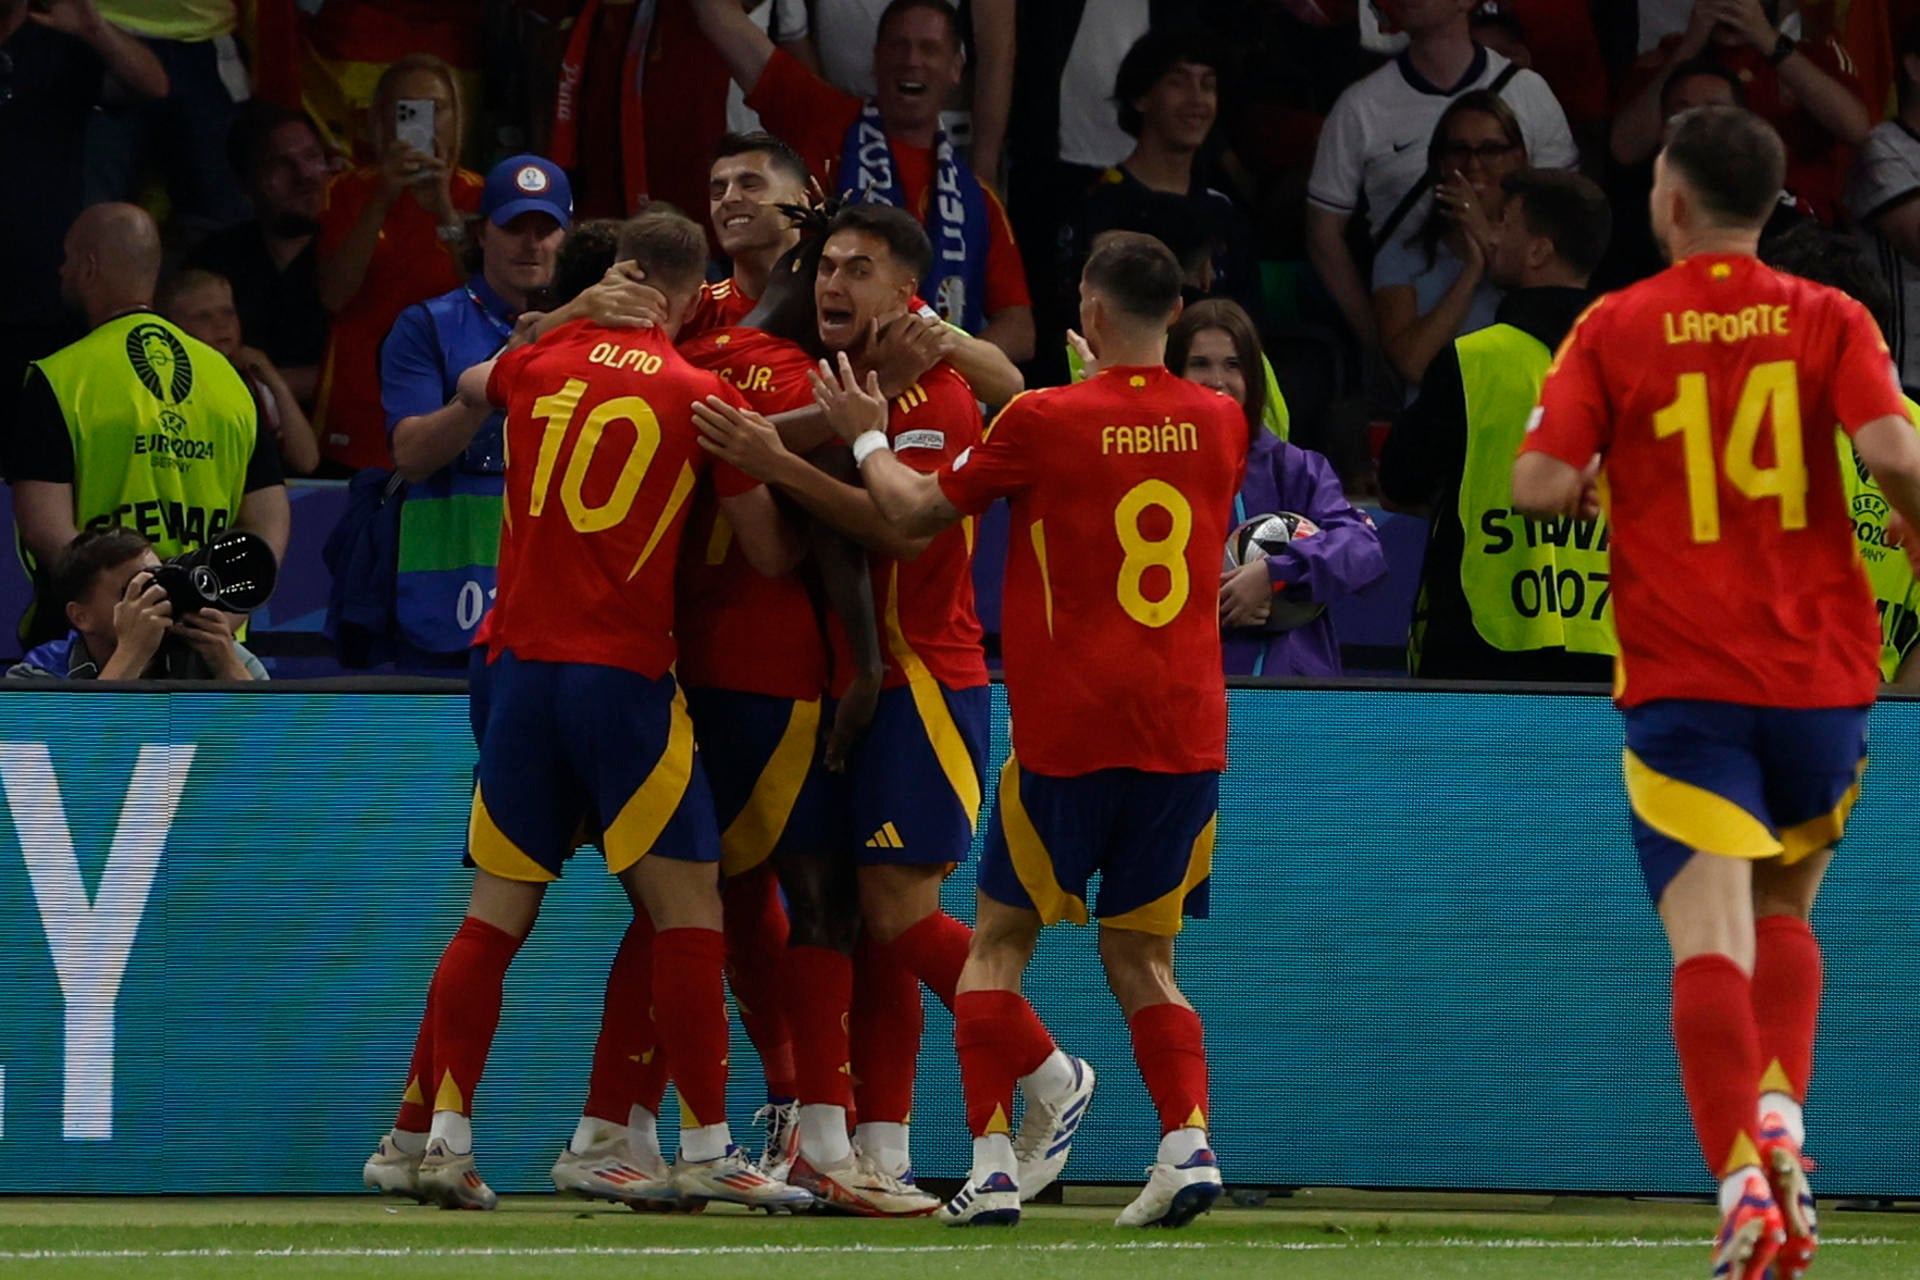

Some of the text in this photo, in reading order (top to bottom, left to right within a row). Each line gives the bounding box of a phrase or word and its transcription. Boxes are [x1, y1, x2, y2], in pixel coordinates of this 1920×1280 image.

[1663, 303, 1792, 345] LAPORTE
[588, 342, 664, 376] OLMO
[735, 364, 777, 393] JR.
[134, 433, 215, 460] EUR2024
[529, 377, 662, 534] 10
[1101, 415, 1199, 456] FABIÁN
[1652, 359, 1811, 545] 14
[1481, 506, 1610, 554] STEW
[1853, 497, 1886, 519] UEFA
[1114, 478, 1193, 629] 8
[456, 580, 498, 631] 0
[1511, 564, 1612, 621] 0107
[0, 741, 199, 1142] Y
